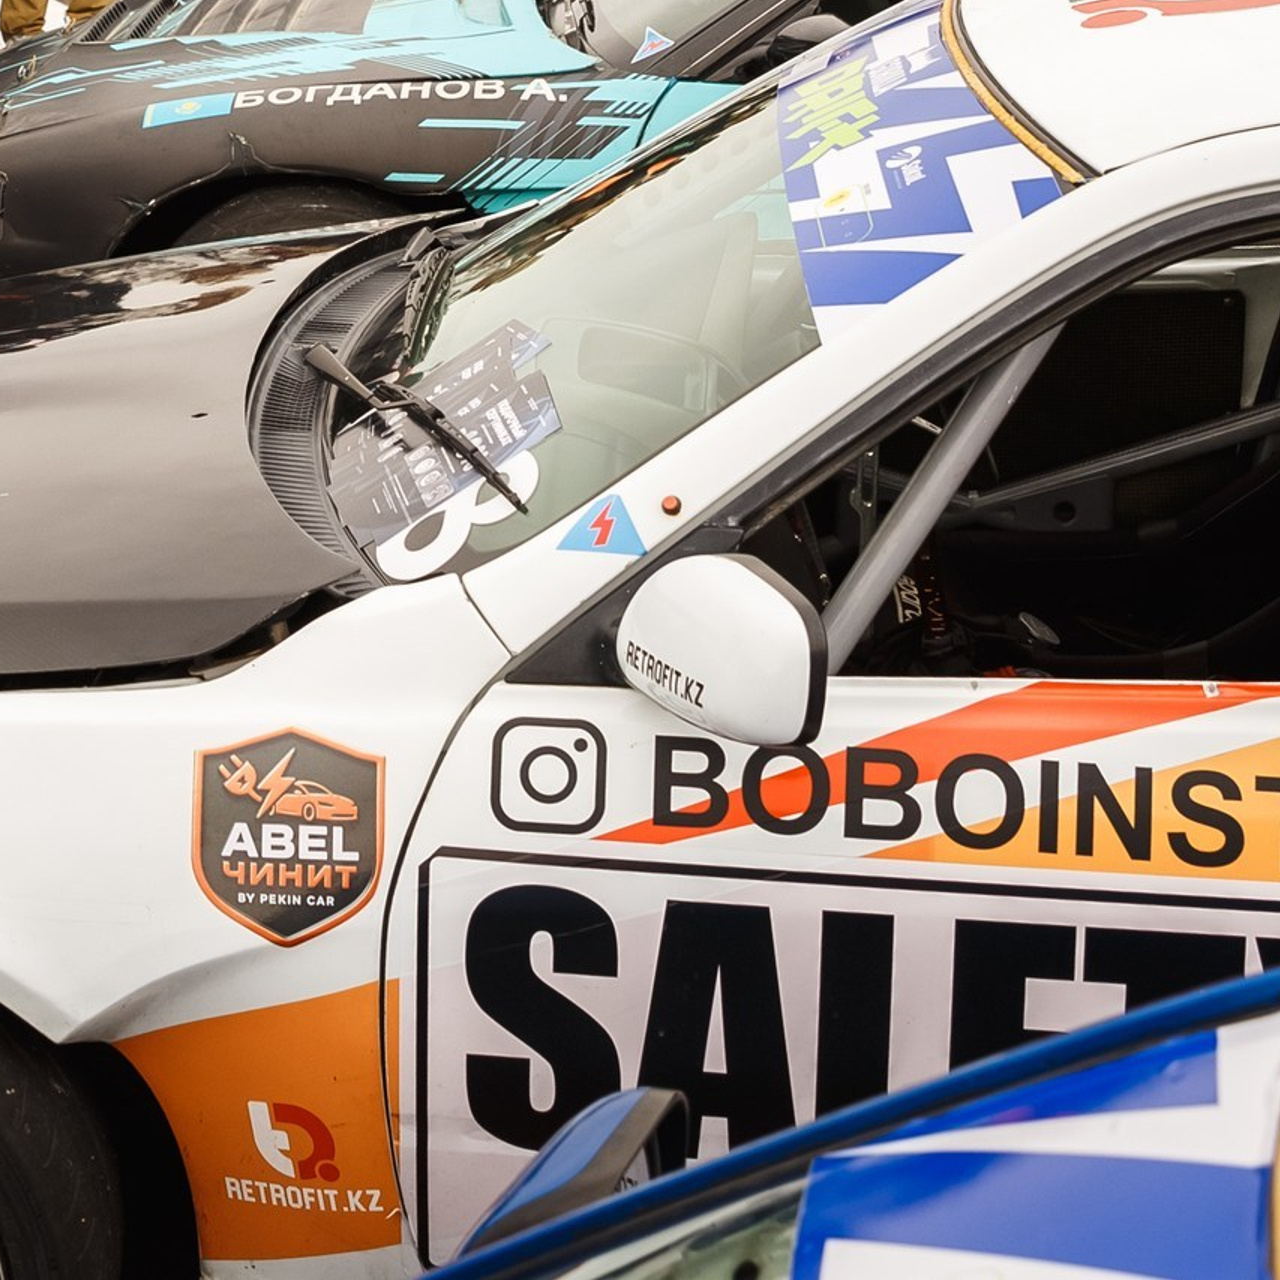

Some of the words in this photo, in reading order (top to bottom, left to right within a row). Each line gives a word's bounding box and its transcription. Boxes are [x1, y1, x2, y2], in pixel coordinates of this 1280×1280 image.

[233, 80, 506, 110] БОГДАНОВ
[520, 78, 568, 102] А.
[626, 640, 705, 708] RETROFIT.KZ
[221, 821, 360, 862] ABEL
[222, 860, 358, 890] ЧИНИТ
[237, 892, 255, 904] BY
[260, 894, 302, 906] PEKIN
[306, 895, 335, 907] CAR
[224, 1176, 385, 1213] RETROFIT.KZ
